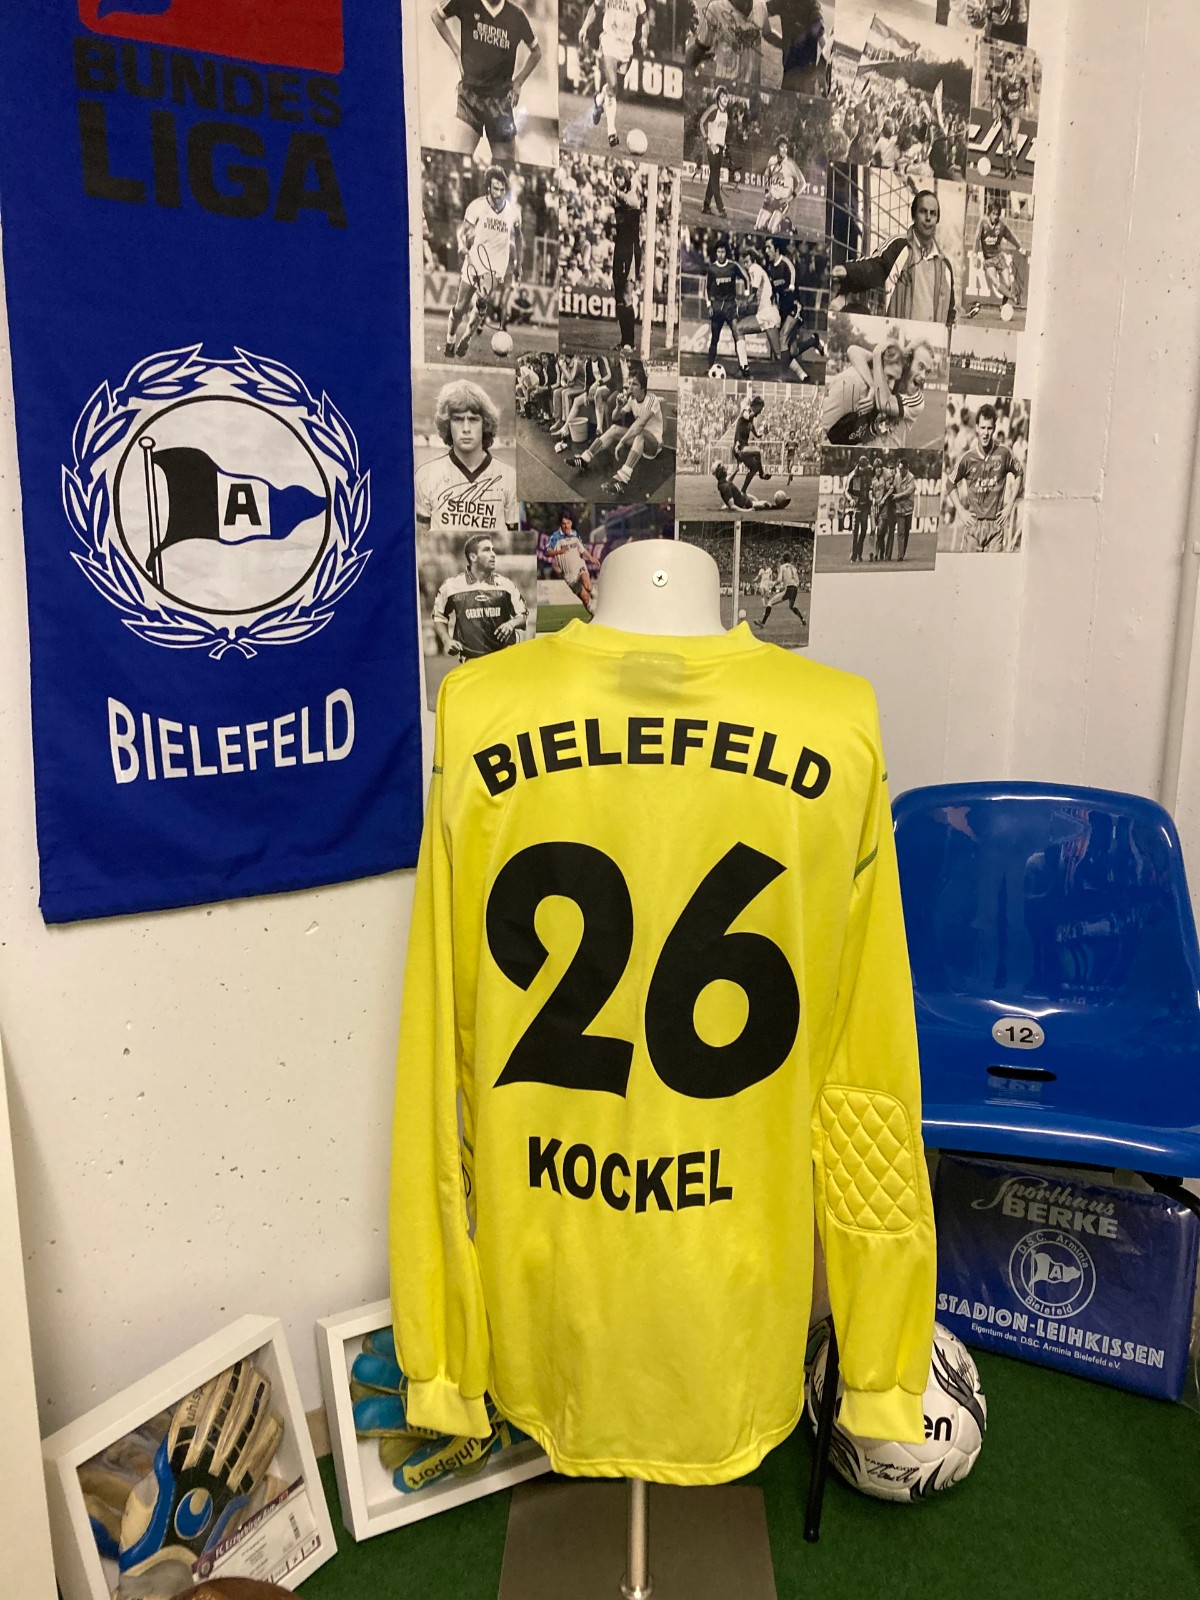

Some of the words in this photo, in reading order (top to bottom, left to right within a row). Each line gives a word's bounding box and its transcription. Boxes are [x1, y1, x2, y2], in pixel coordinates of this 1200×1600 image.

[472, 29, 511, 49] STICKER
[476, 21, 508, 40] SEIDEN
[73, 36, 342, 128] BUNDES
[76, 97, 347, 229] LIGA
[483, 222, 509, 233] STICKER
[224, 483, 262, 526] A
[441, 512, 497, 529] STICKER
[447, 499, 495, 516] SEIDEN
[465, 607, 484, 619] GERRY
[107, 688, 355, 784] BIELEFELD
[472, 717, 832, 800] BIELEFELD
[485, 841, 800, 1100] 26
[1005, 1026, 1034, 1044] 12
[528, 1136, 733, 1214] KOCKEL
[970, 1176, 1115, 1216] Sporthaus
[1002, 1196, 1119, 1239] BERKE
[1018, 1232, 1047, 1255] D.S.C.
[1056, 1234, 1089, 1269] Arminia
[1024, 1295, 1073, 1316] Bielefeld
[936, 1293, 1165, 1369] STADION-LEIHKISSEN
[971, 1322, 1003, 1338] Eigentum
[1004, 1332, 1017, 1342] des
[1042, 1342, 1072, 1357] Arminia
[1073, 1350, 1107, 1367] Bielefeld
[408, 1437, 479, 1485] uhlsport
